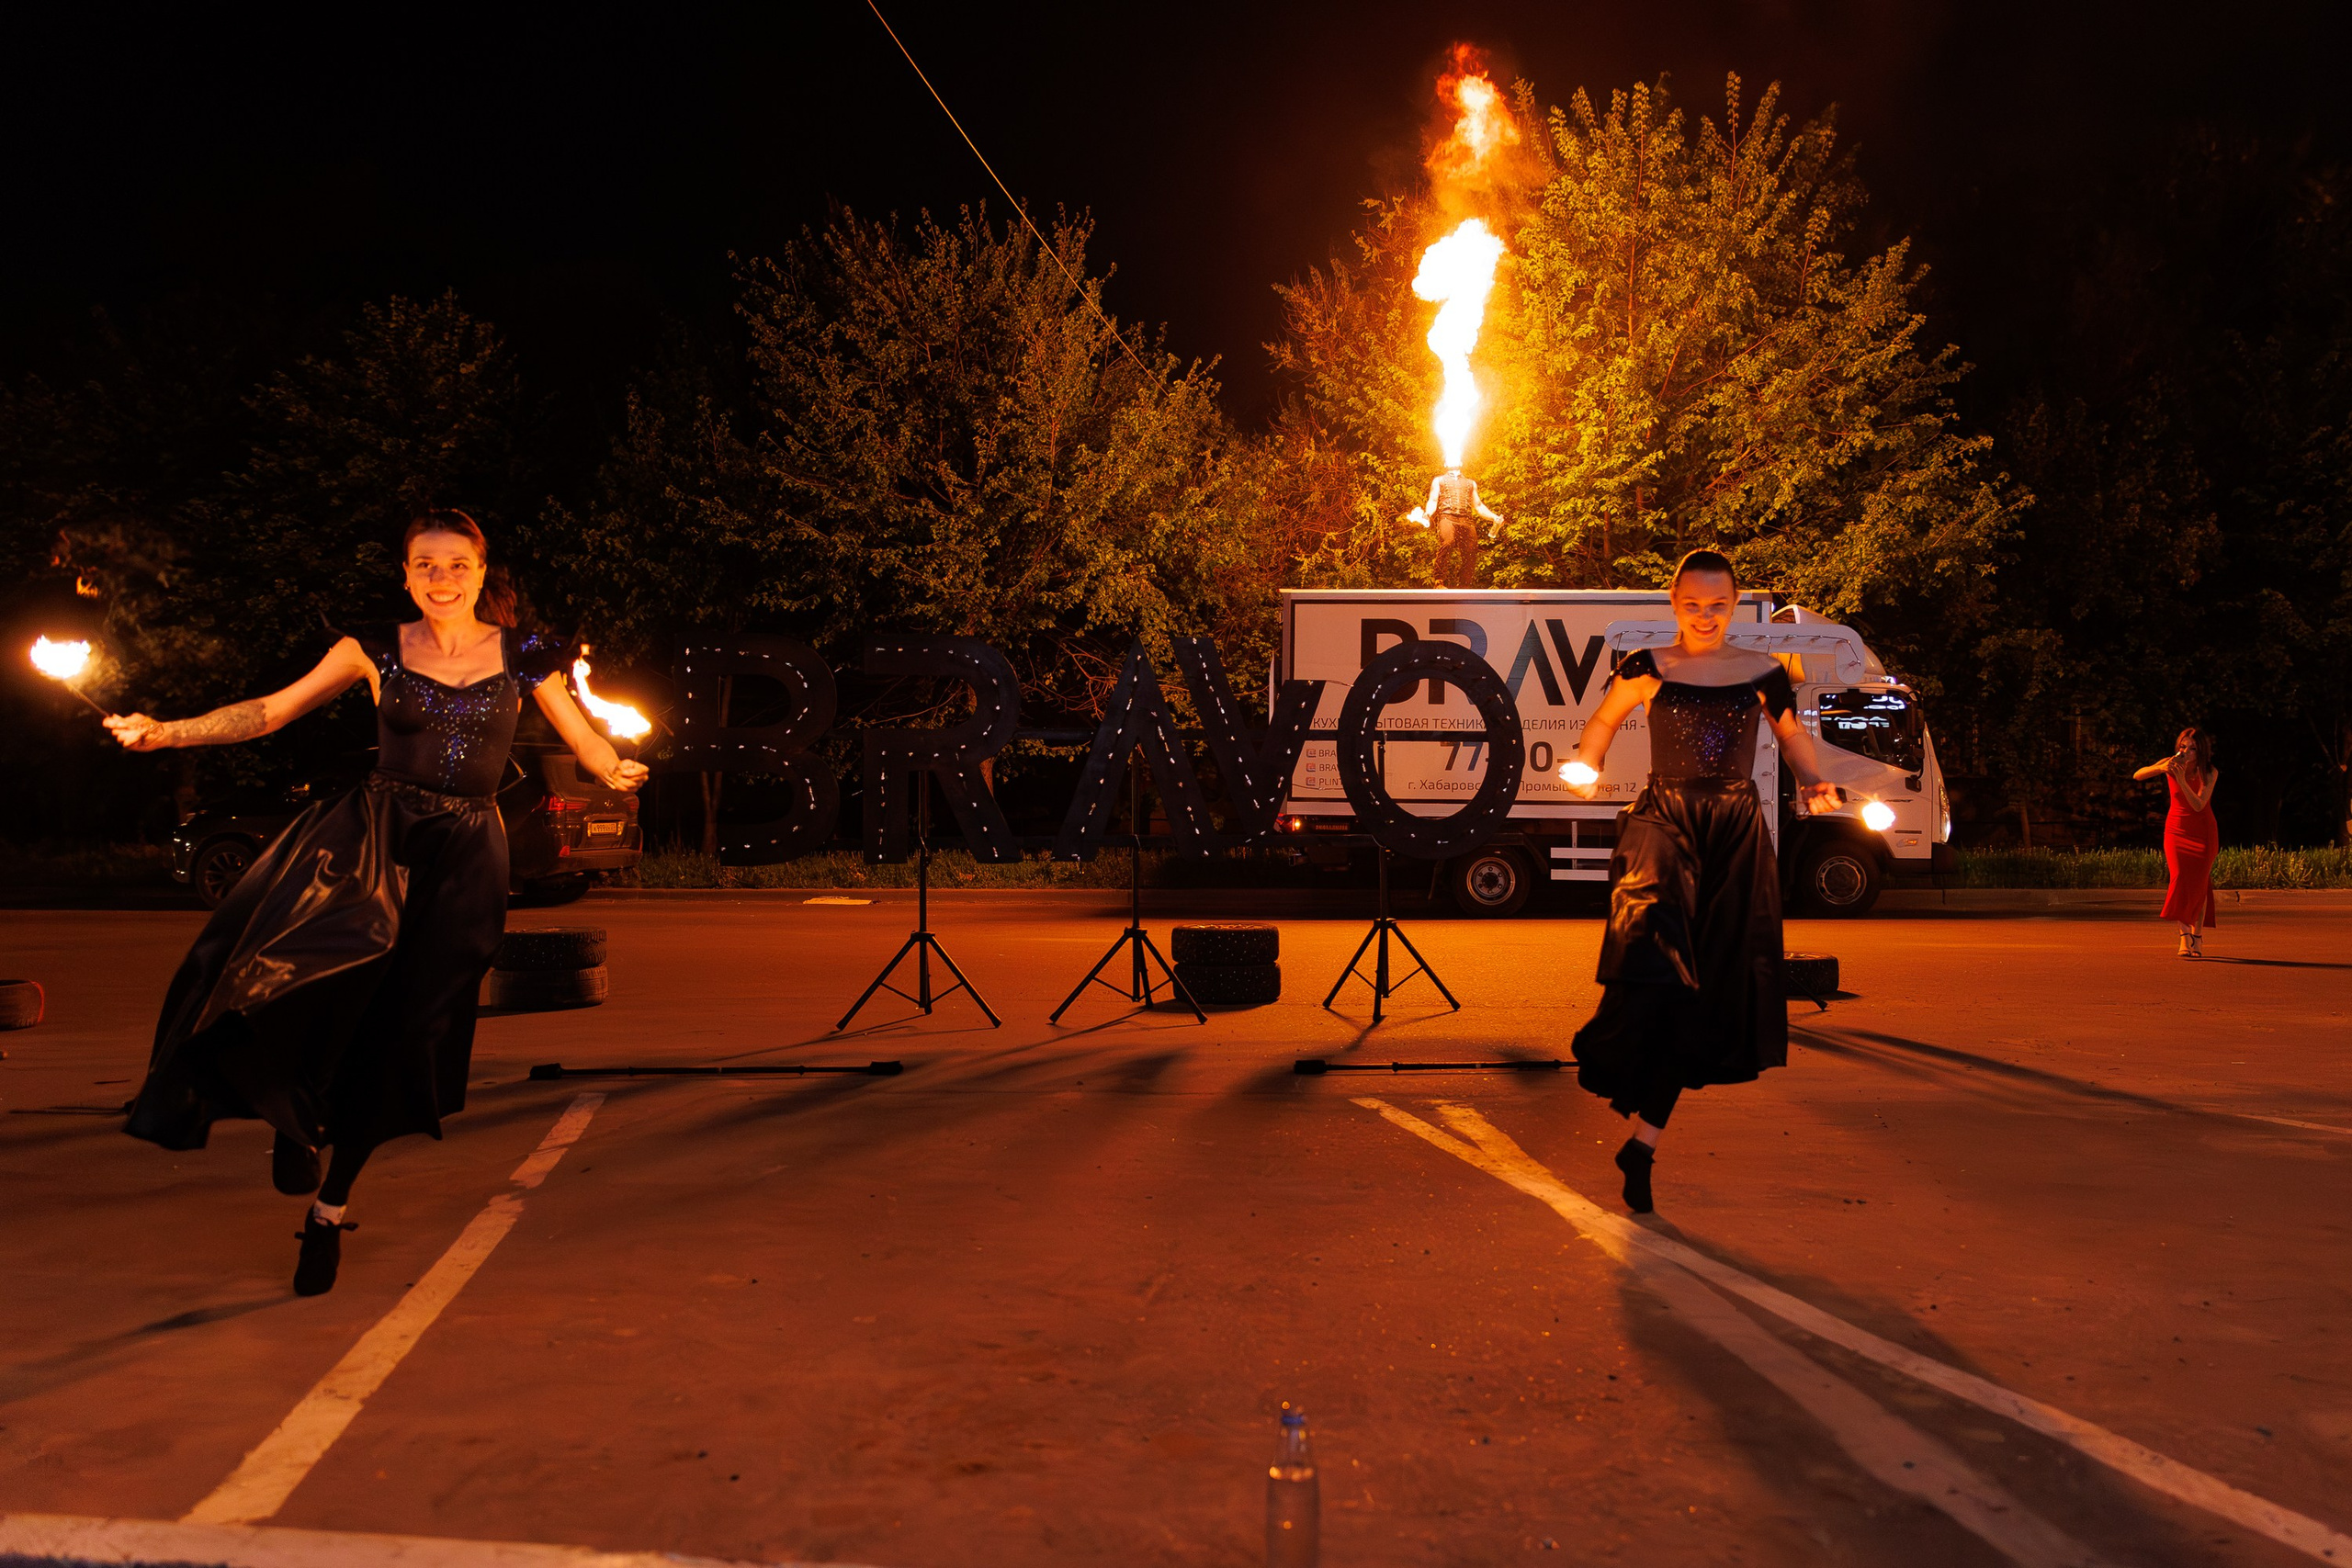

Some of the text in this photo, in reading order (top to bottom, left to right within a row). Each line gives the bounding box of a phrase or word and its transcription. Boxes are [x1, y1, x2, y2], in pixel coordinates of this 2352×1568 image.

[1361, 618, 1630, 706] BRAV
[673, 632, 1525, 865] BRAVO
[1432, 718, 1487, 729] ТЕХНИК
[1419, 779, 1481, 791] Хабаровс
[1624, 783, 1637, 793] 12
